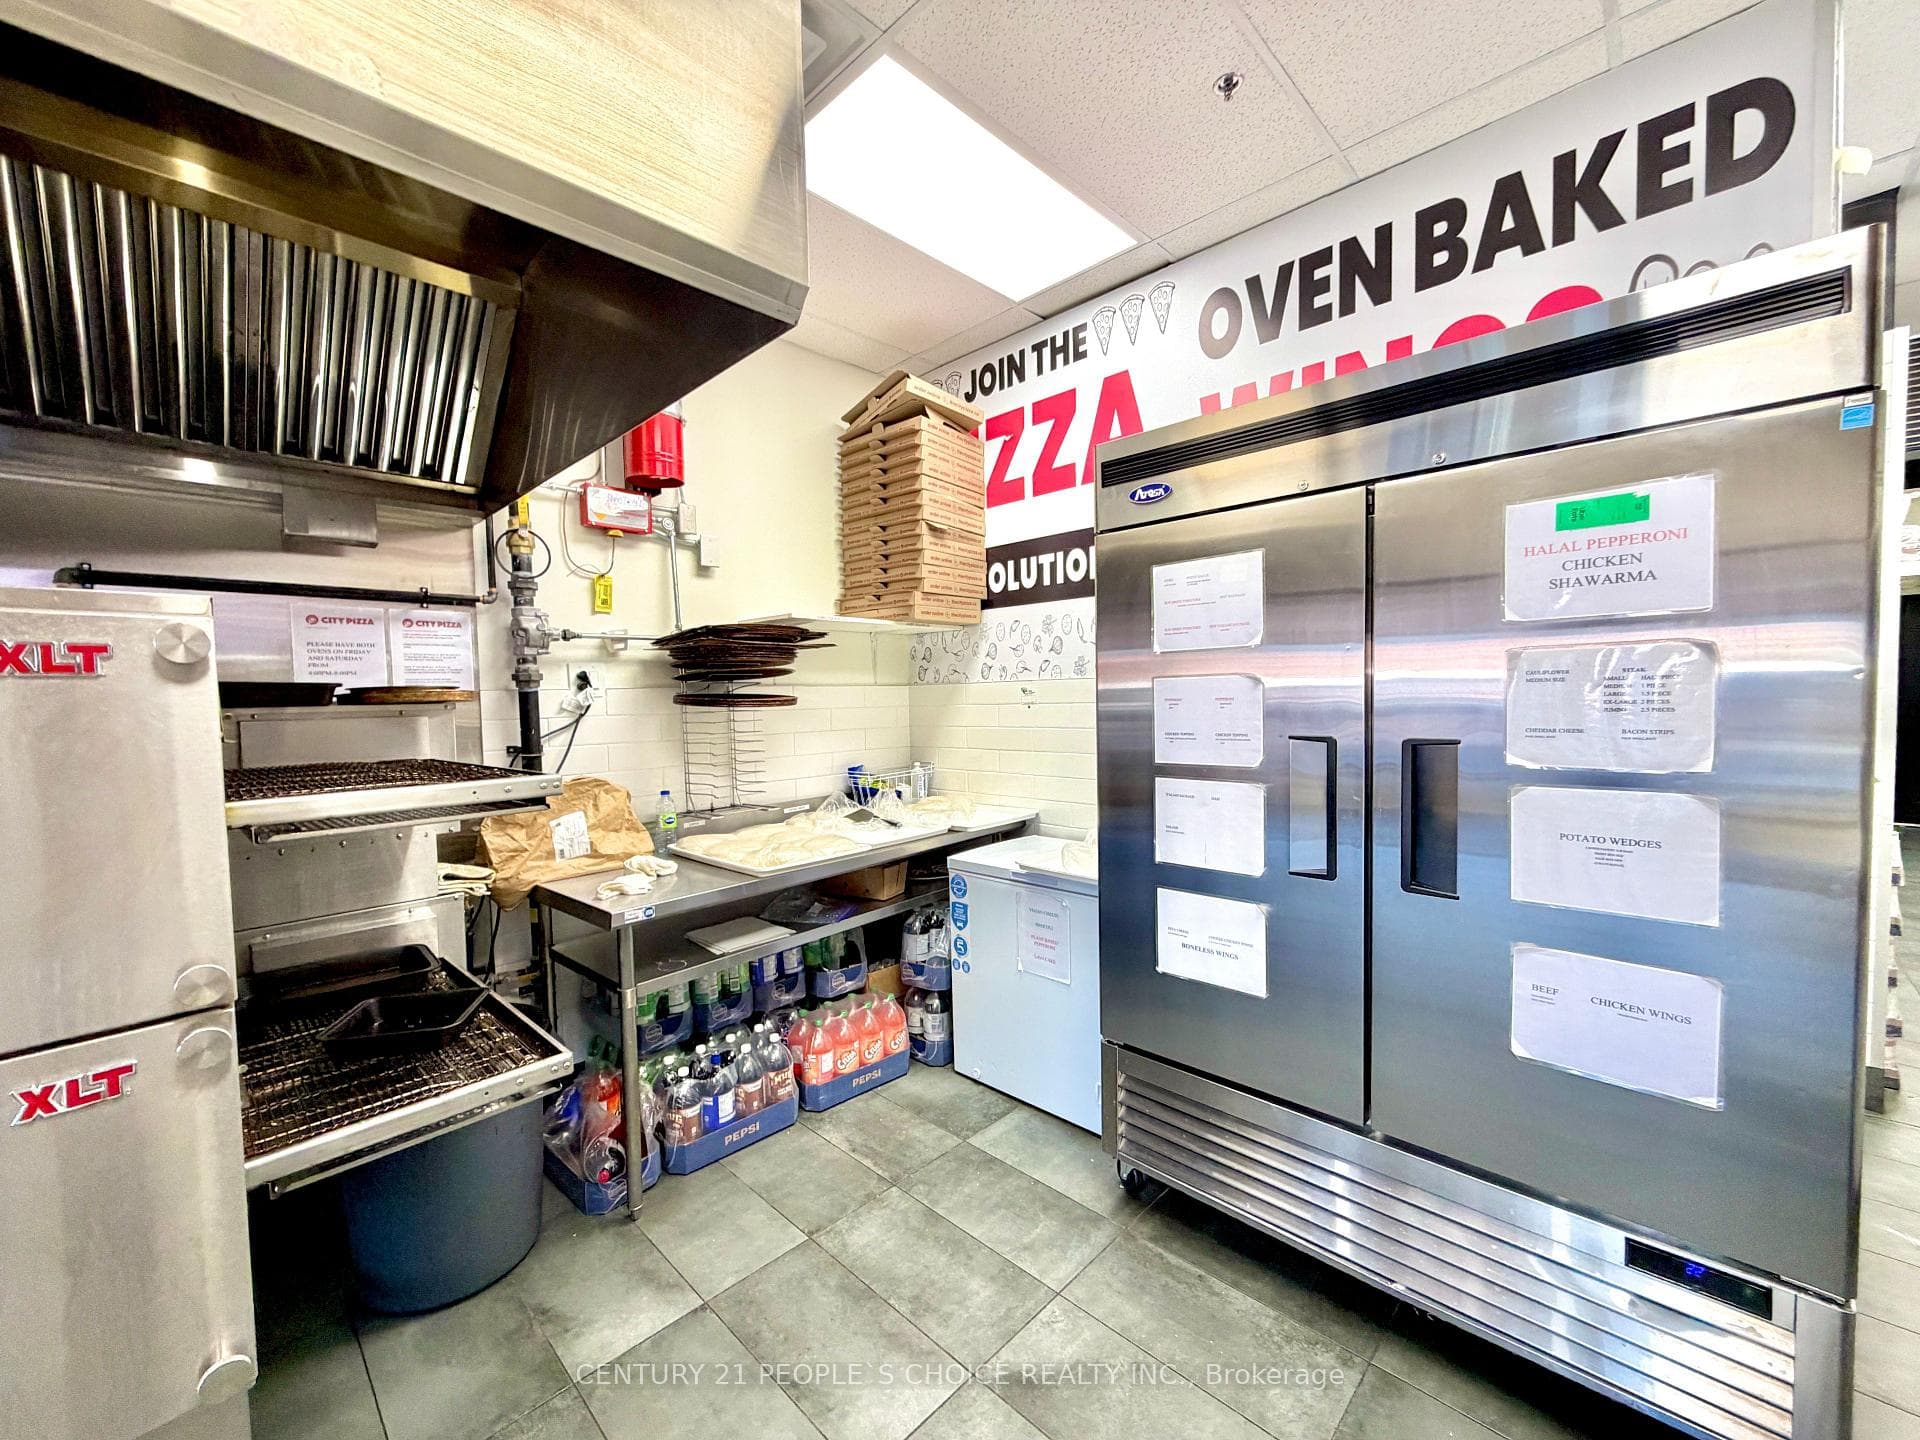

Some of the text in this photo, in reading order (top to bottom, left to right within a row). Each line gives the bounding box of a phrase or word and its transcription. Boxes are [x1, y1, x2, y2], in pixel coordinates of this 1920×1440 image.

[1198, 221, 1393, 360] OVEN
[1415, 76, 1796, 293] BAKED
[964, 322, 1088, 403] JOIN THE
[970, 369, 1144, 509] ZZA
[1523, 527, 1689, 558] HALAL PEPPERONI
[1562, 552, 1643, 572] CHICKEN
[1549, 569, 1657, 590] SHAWARMA
[321, 616, 344, 624] CITY
[0, 641, 111, 675] XLT
[1559, 832, 1662, 850] POTATO WEDGES
[1181, 942, 1214, 955] BONELESS
[1216, 950, 1239, 960] WINGS
[1532, 984, 1559, 996] BEEF
[1590, 996, 1646, 1015] CHICKEN
[1648, 1008, 1692, 1025] WINGS
[852, 1068, 881, 1088] PEPSI
[14, 1062, 135, 1123] XLT
[724, 1122, 760, 1146] PEPSI
